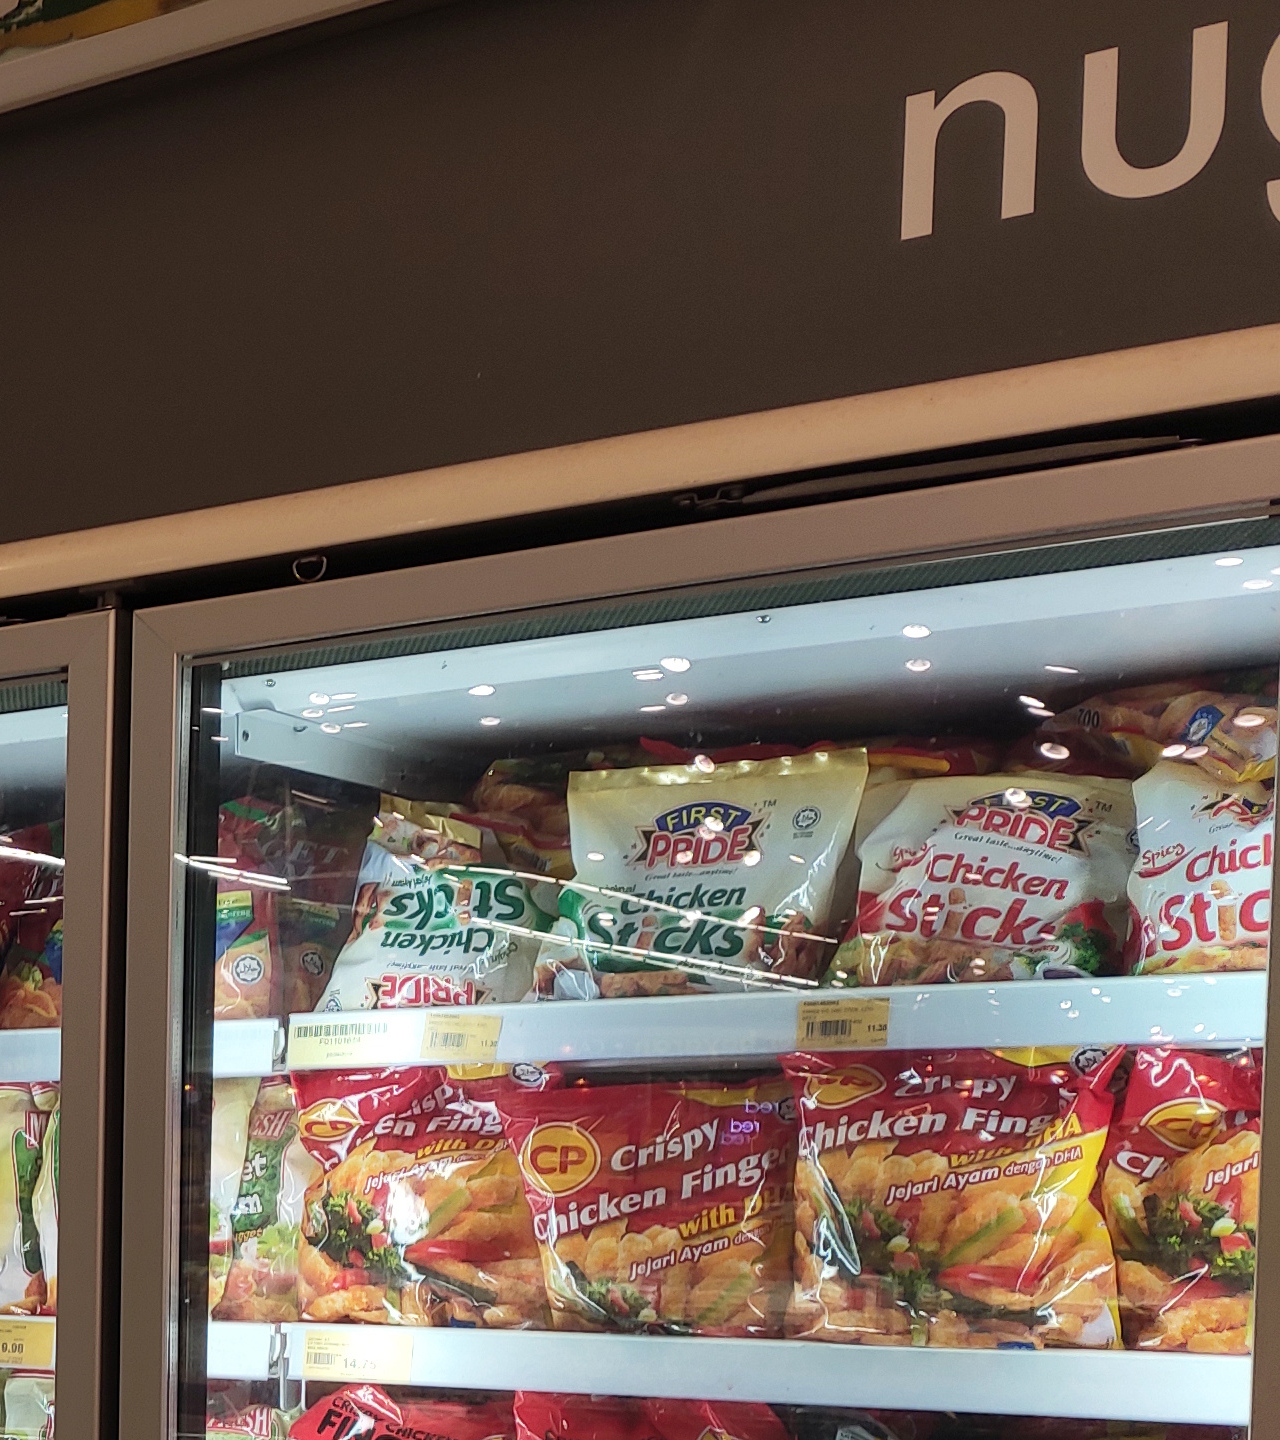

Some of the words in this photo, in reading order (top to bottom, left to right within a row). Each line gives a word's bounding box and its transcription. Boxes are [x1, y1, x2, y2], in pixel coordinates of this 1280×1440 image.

[900, 20, 1280, 241] nu
[648, 826, 757, 869] PRIDE
[956, 807, 1077, 854] PRIDE
[1141, 842, 1186, 866] Spicy
[621, 882, 747, 916] Chicken
[926, 853, 1070, 901] Chicken
[384, 877, 526, 931] Sticks
[886, 888, 1057, 945] Sticks
[380, 927, 495, 957] Chicken
[589, 911, 746, 958] Sticks
[611, 1117, 720, 1172] Crispy
[798, 1109, 948, 1152] Chicken
[528, 1143, 587, 1176] CP
[887, 1178, 938, 1206] Jejari
[943, 1164, 1000, 1190] Ayam
[1005, 1157, 1051, 1178] dengan
[1053, 1147, 1083, 1167] DHA
[534, 1186, 667, 1242] Chicken
[679, 1207, 737, 1240] with
[629, 1250, 675, 1280] Jejari
[679, 1235, 730, 1265] Ayam
